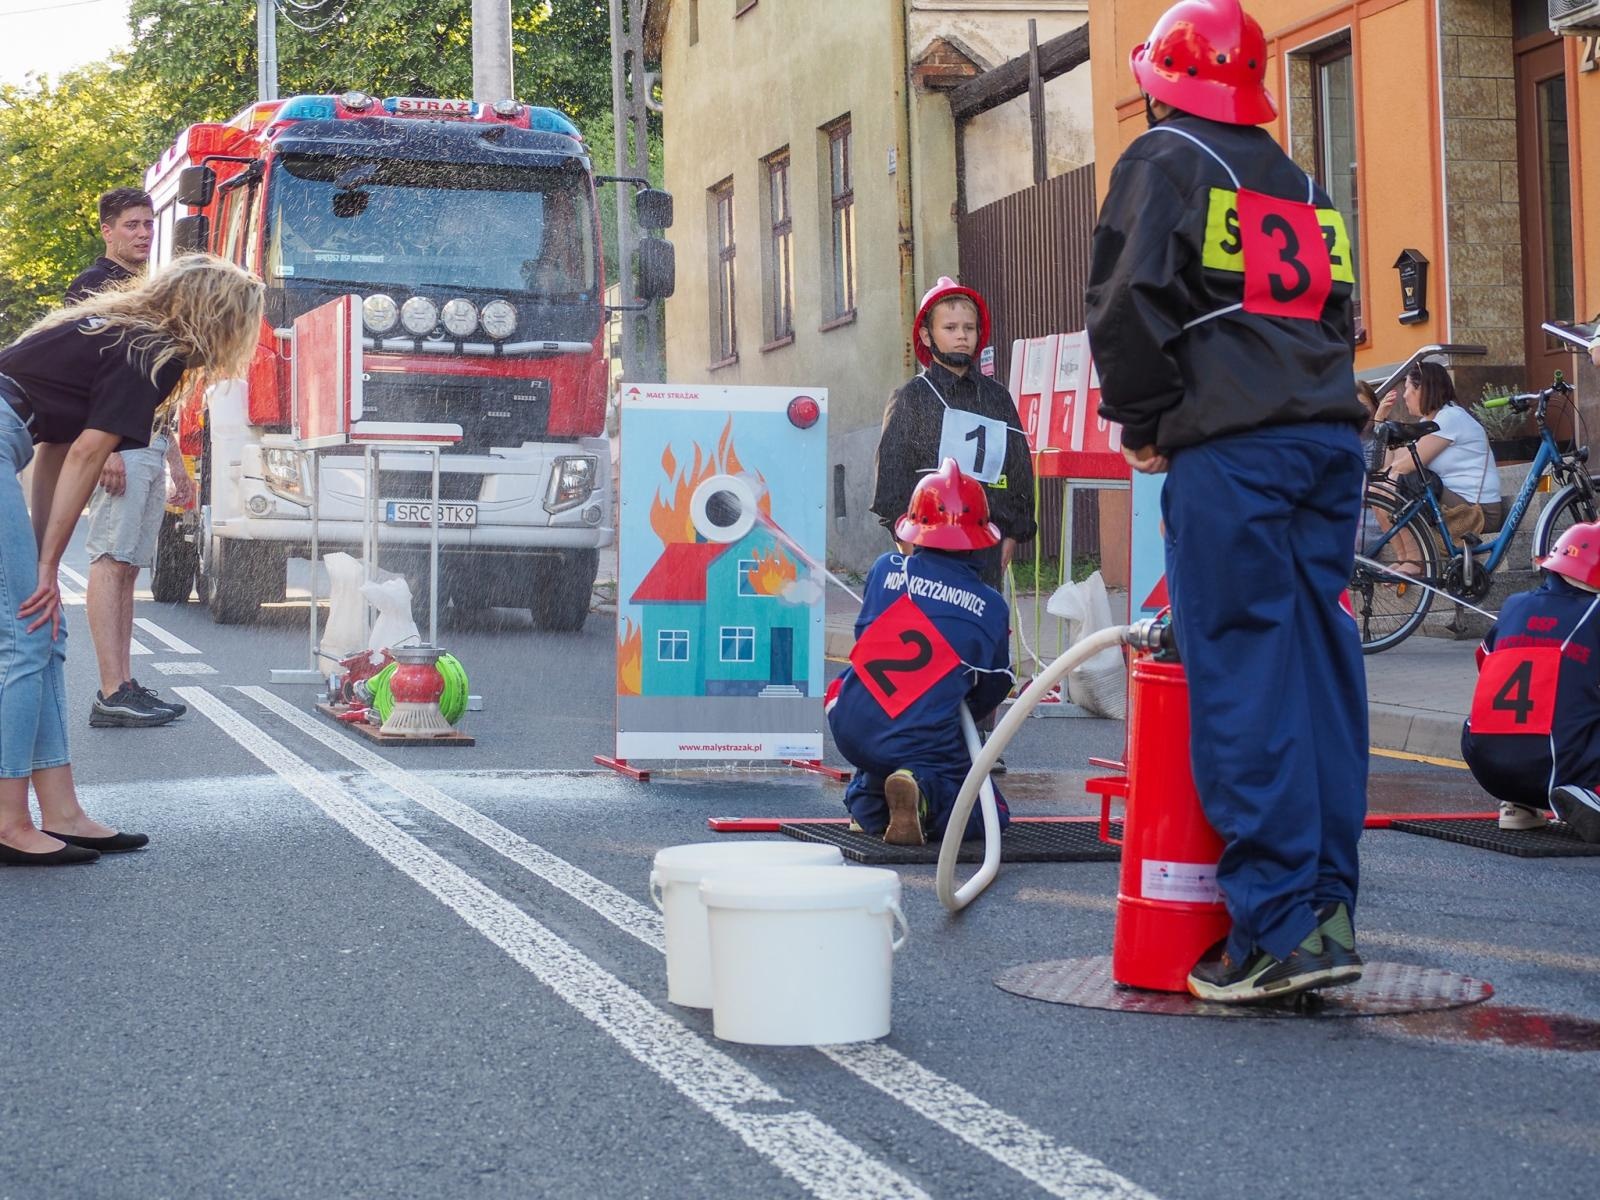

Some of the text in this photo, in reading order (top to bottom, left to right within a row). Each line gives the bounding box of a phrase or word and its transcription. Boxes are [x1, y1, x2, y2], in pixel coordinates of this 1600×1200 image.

[399, 100, 469, 112] STRAŻ
[1261, 213, 1312, 303] 3
[1028, 397, 1038, 435] 6
[1063, 394, 1073, 433] 7
[965, 424, 987, 474] 1
[883, 571, 987, 617] MDP KRZYŻANOWICE
[864, 629, 933, 697] 2
[1492, 660, 1535, 725] 4
[679, 743, 762, 753] www.malystrazak.pl
